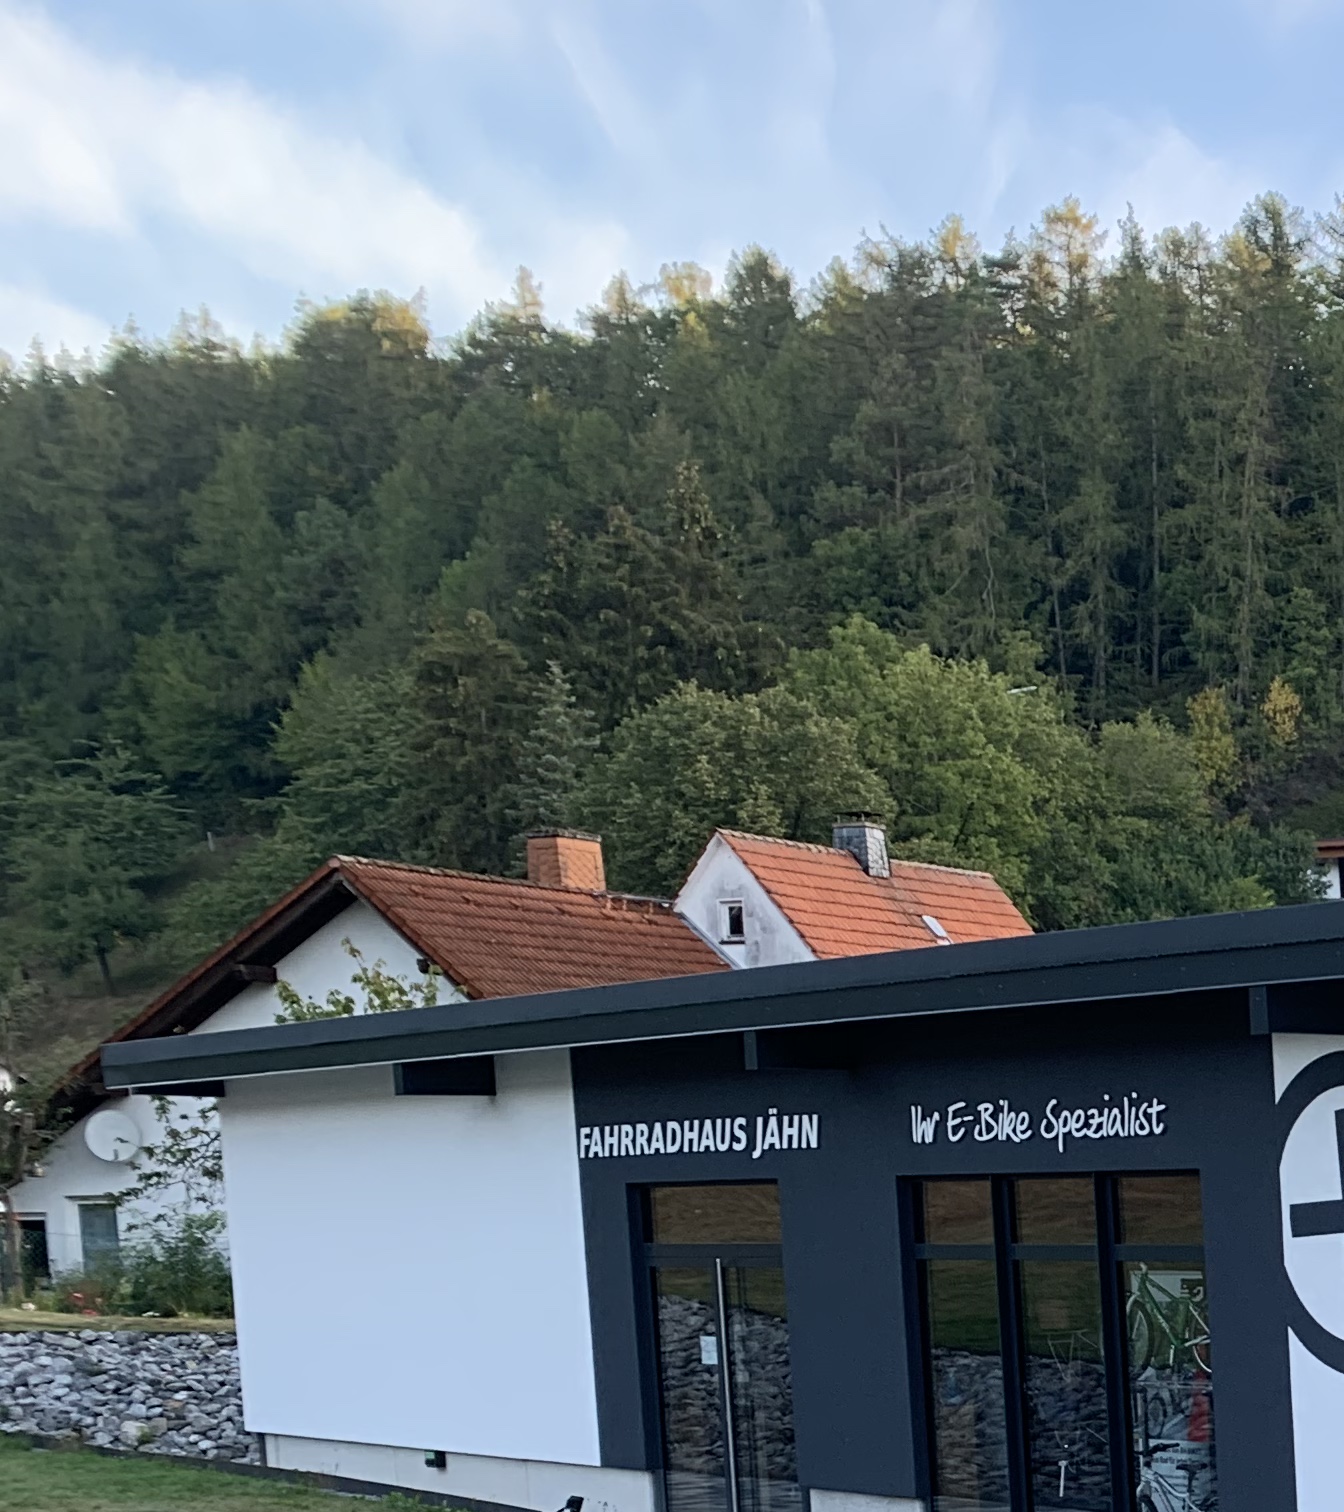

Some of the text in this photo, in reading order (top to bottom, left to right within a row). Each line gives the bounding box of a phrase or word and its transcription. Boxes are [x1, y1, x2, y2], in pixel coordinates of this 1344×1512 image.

[579, 1107, 819, 1159] FAHRRADHAUS JÄHN
[910, 1091, 1166, 1153] Ihr E-Bike Spezialist
